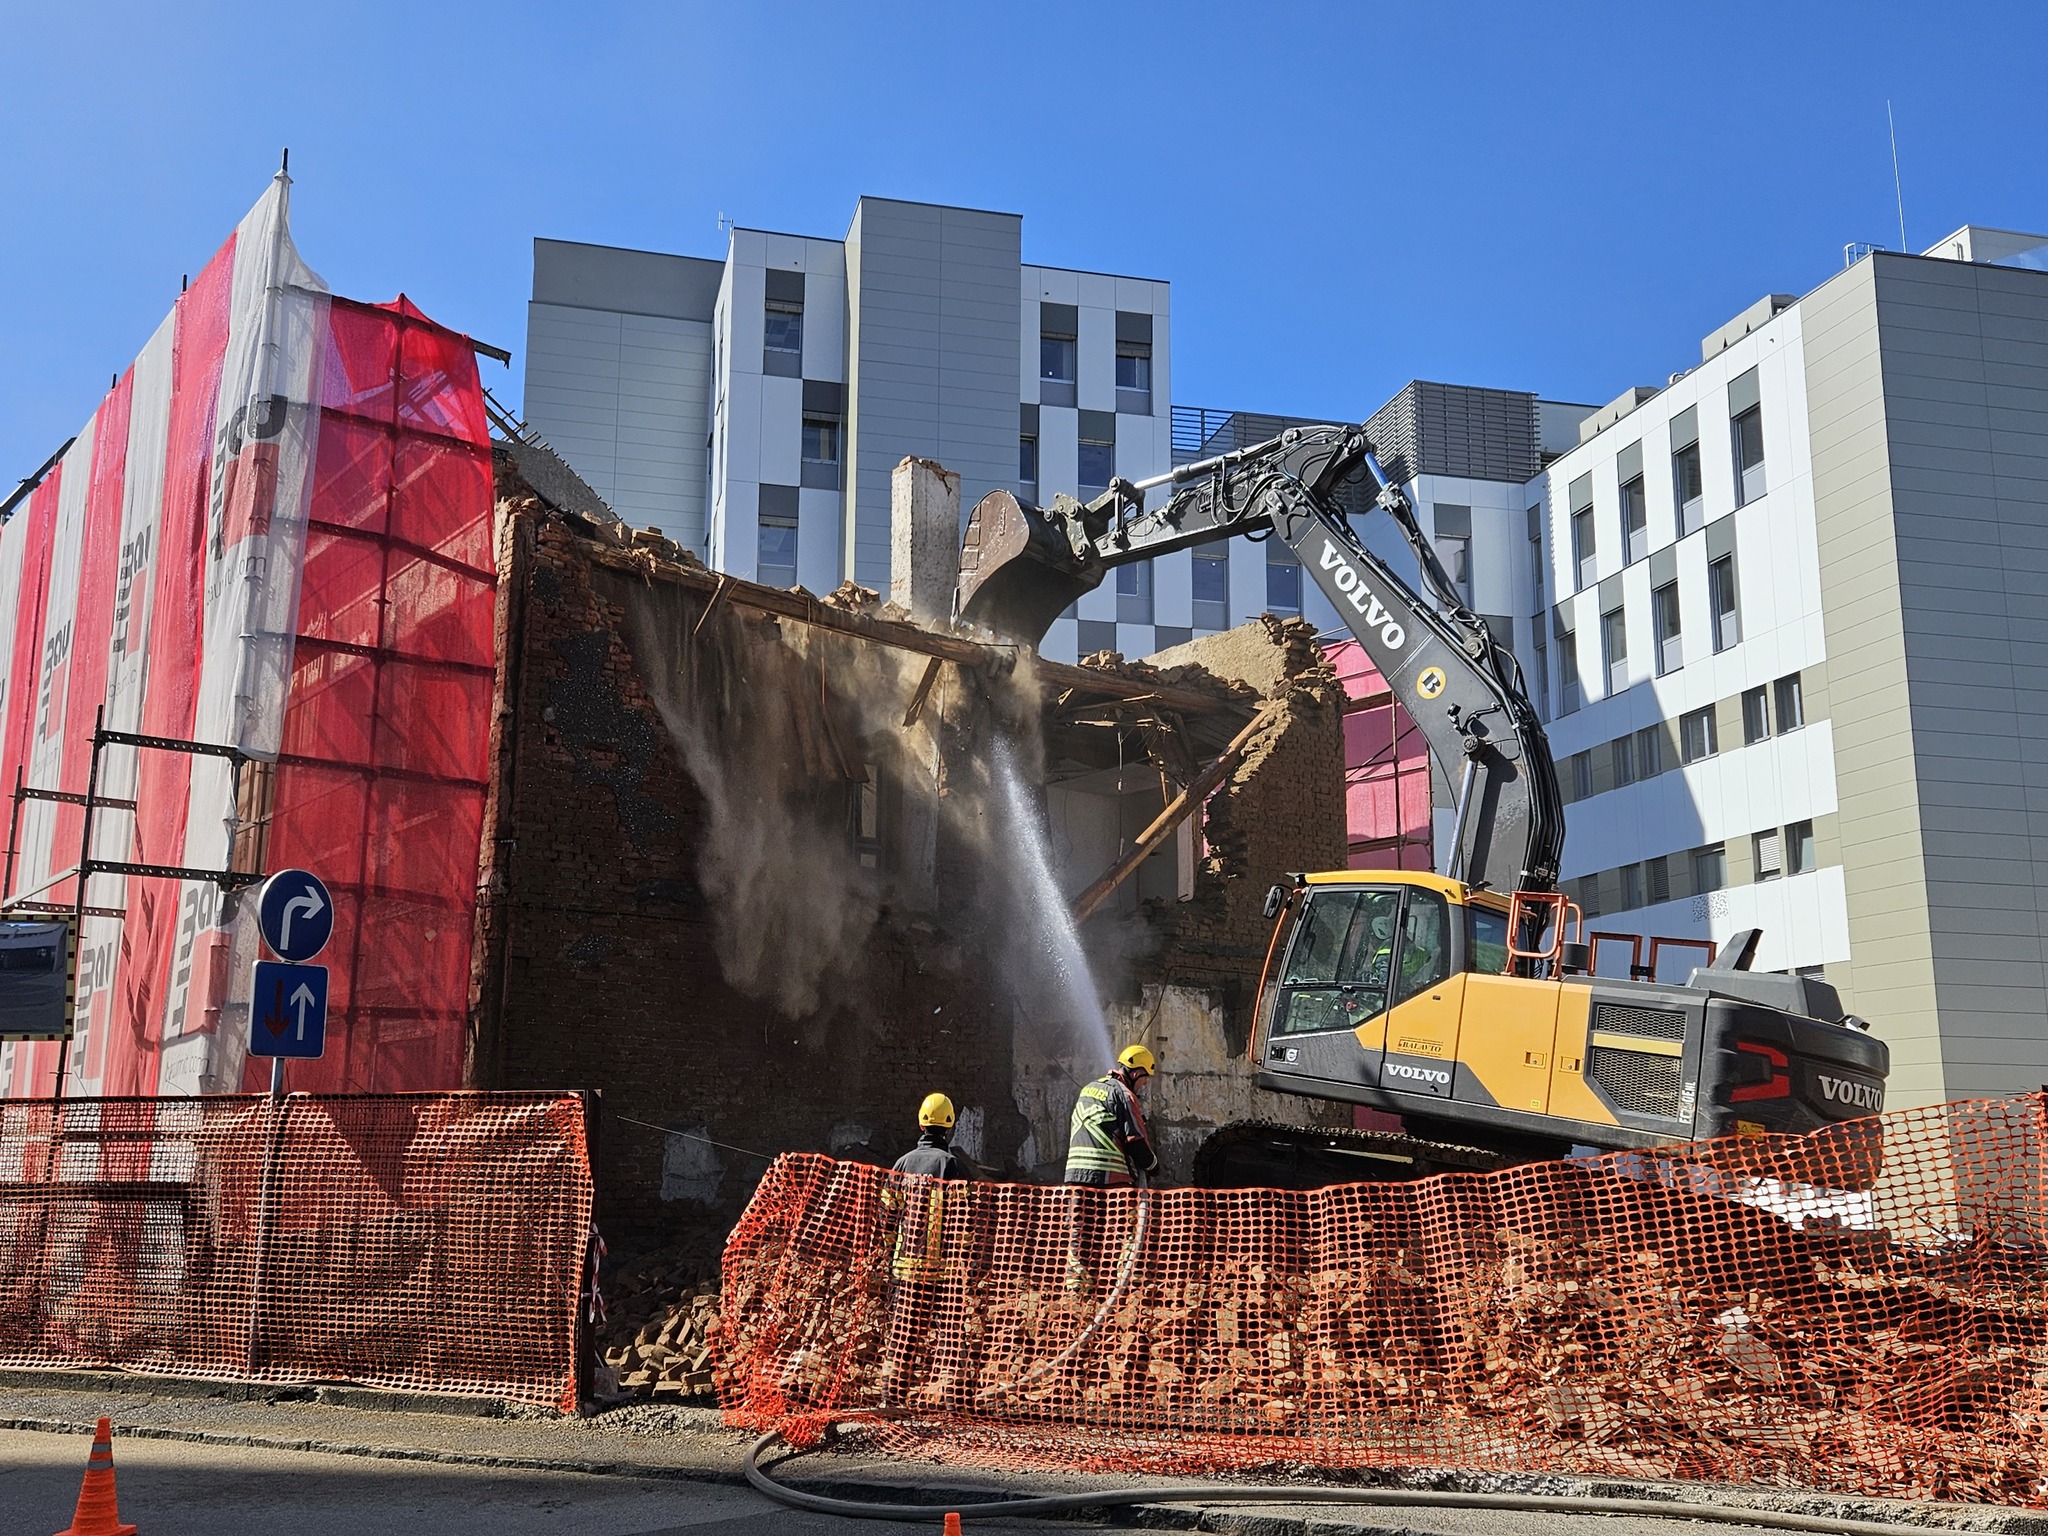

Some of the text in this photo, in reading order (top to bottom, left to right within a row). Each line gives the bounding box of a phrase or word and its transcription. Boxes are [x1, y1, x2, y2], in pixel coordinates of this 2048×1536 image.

[1320, 539, 1405, 649] VOLVO
[1422, 672, 1441, 693] B
[1385, 1063, 1450, 1084] VOLVO
[1818, 1075, 1883, 1112] VOLVO
